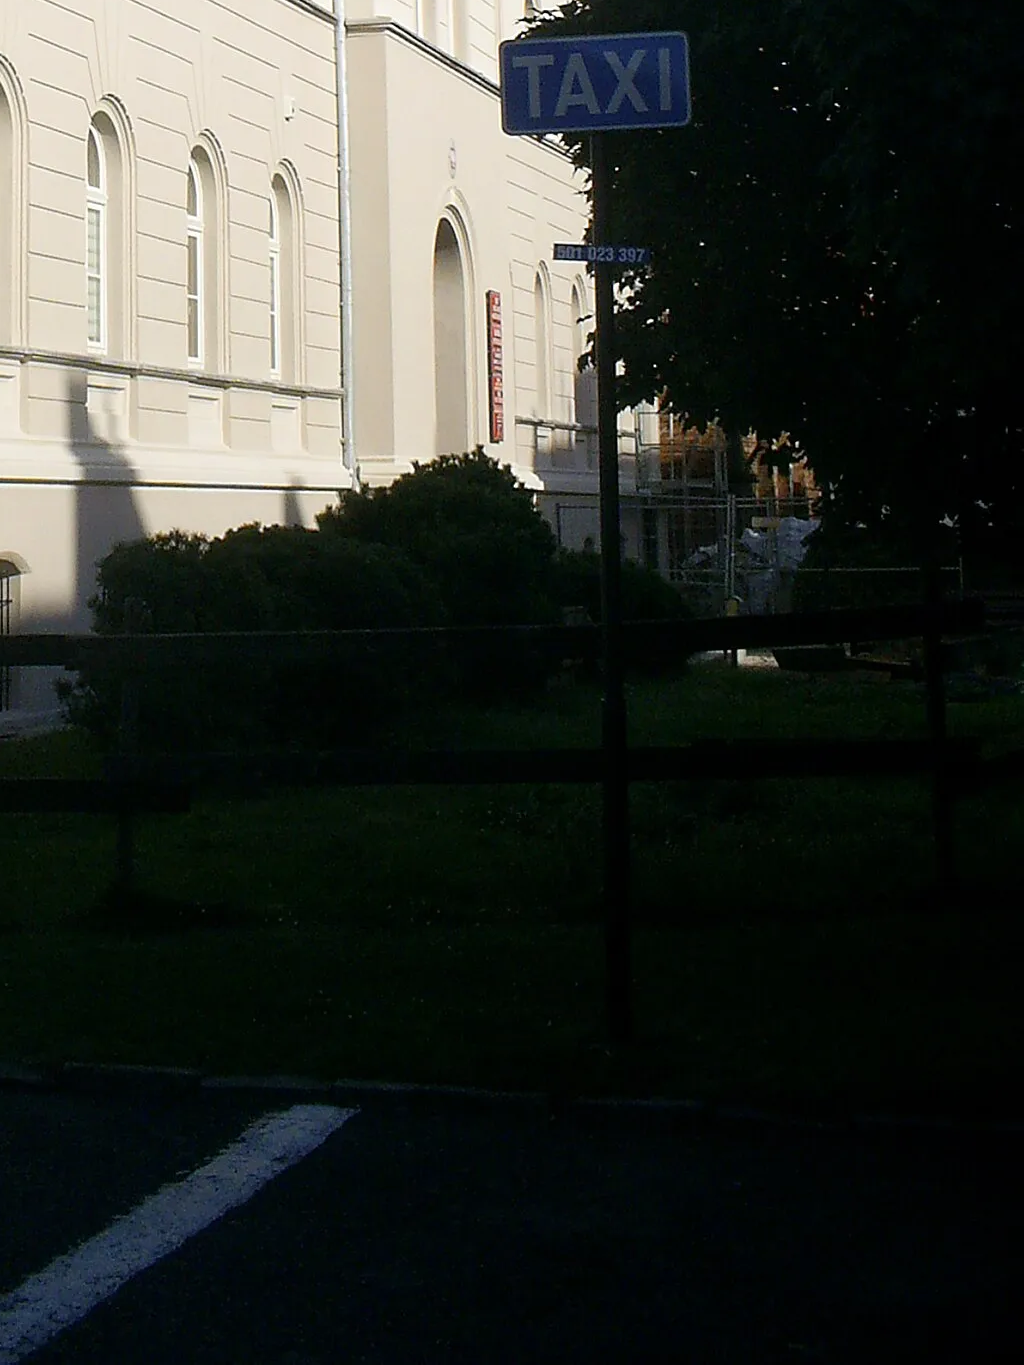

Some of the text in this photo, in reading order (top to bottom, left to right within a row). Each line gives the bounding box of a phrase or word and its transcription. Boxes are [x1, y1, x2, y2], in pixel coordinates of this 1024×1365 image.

[512, 48, 672, 118] TAXI
[556, 245, 645, 262] 501 023 397
